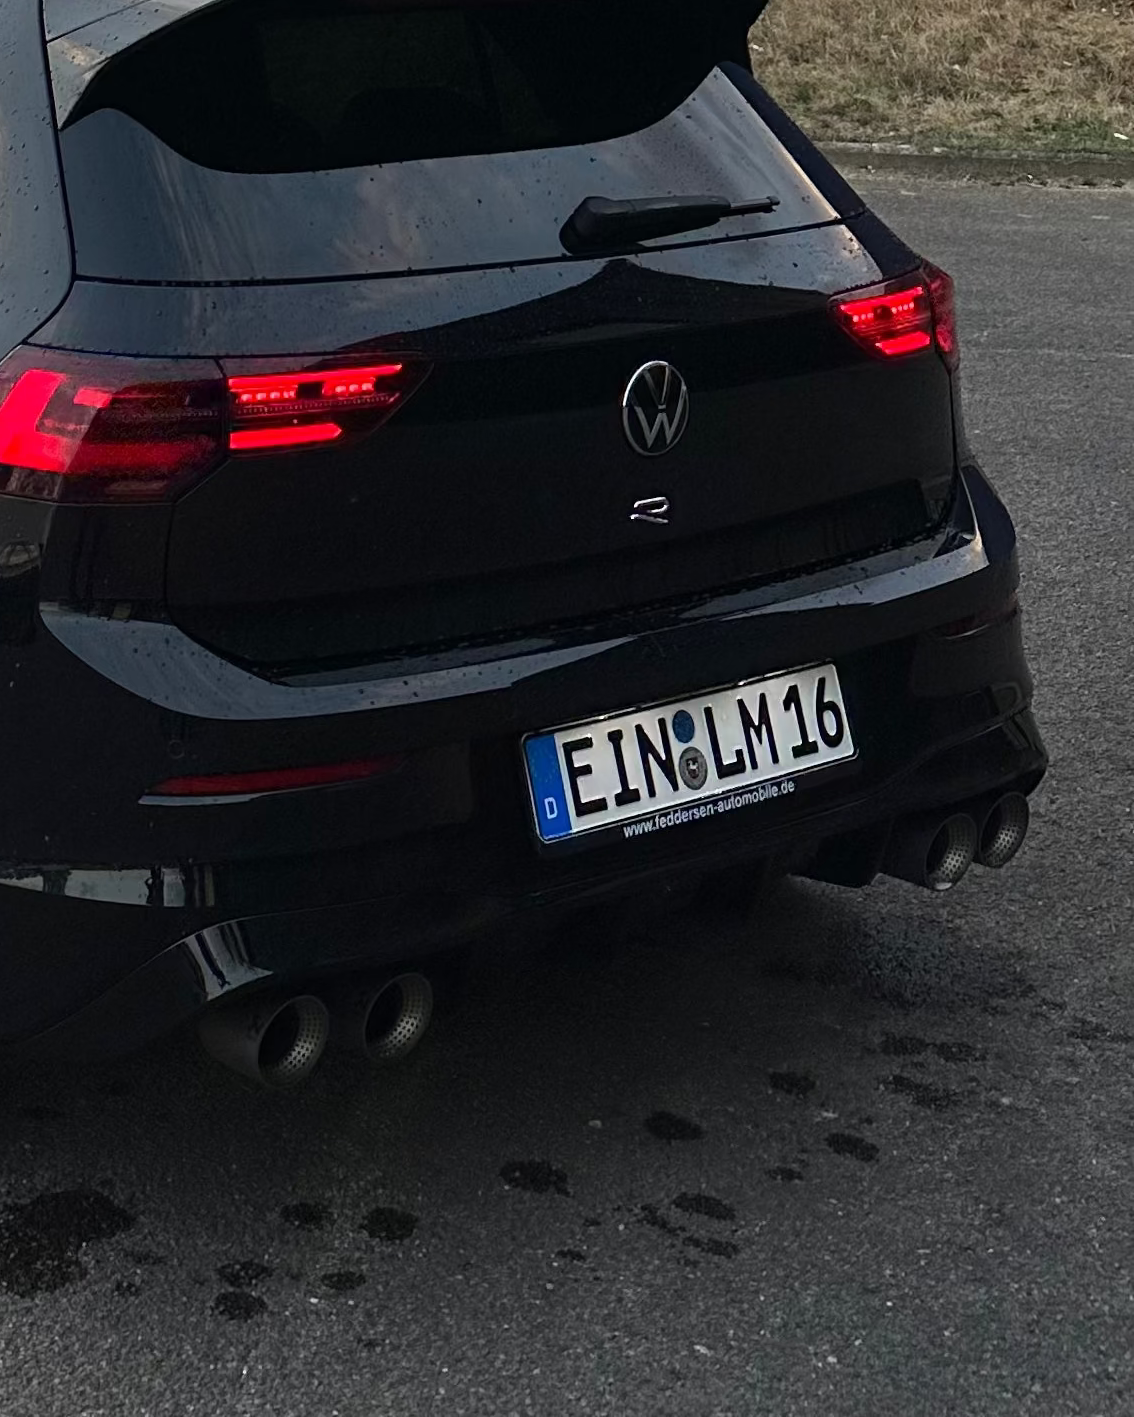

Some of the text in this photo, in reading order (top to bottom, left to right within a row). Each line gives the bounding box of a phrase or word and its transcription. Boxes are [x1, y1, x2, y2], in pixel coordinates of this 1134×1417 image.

[544, 796, 558, 820] D
[562, 717, 679, 818] EIN
[623, 780, 795, 838] www.feddersen-automobile.de
